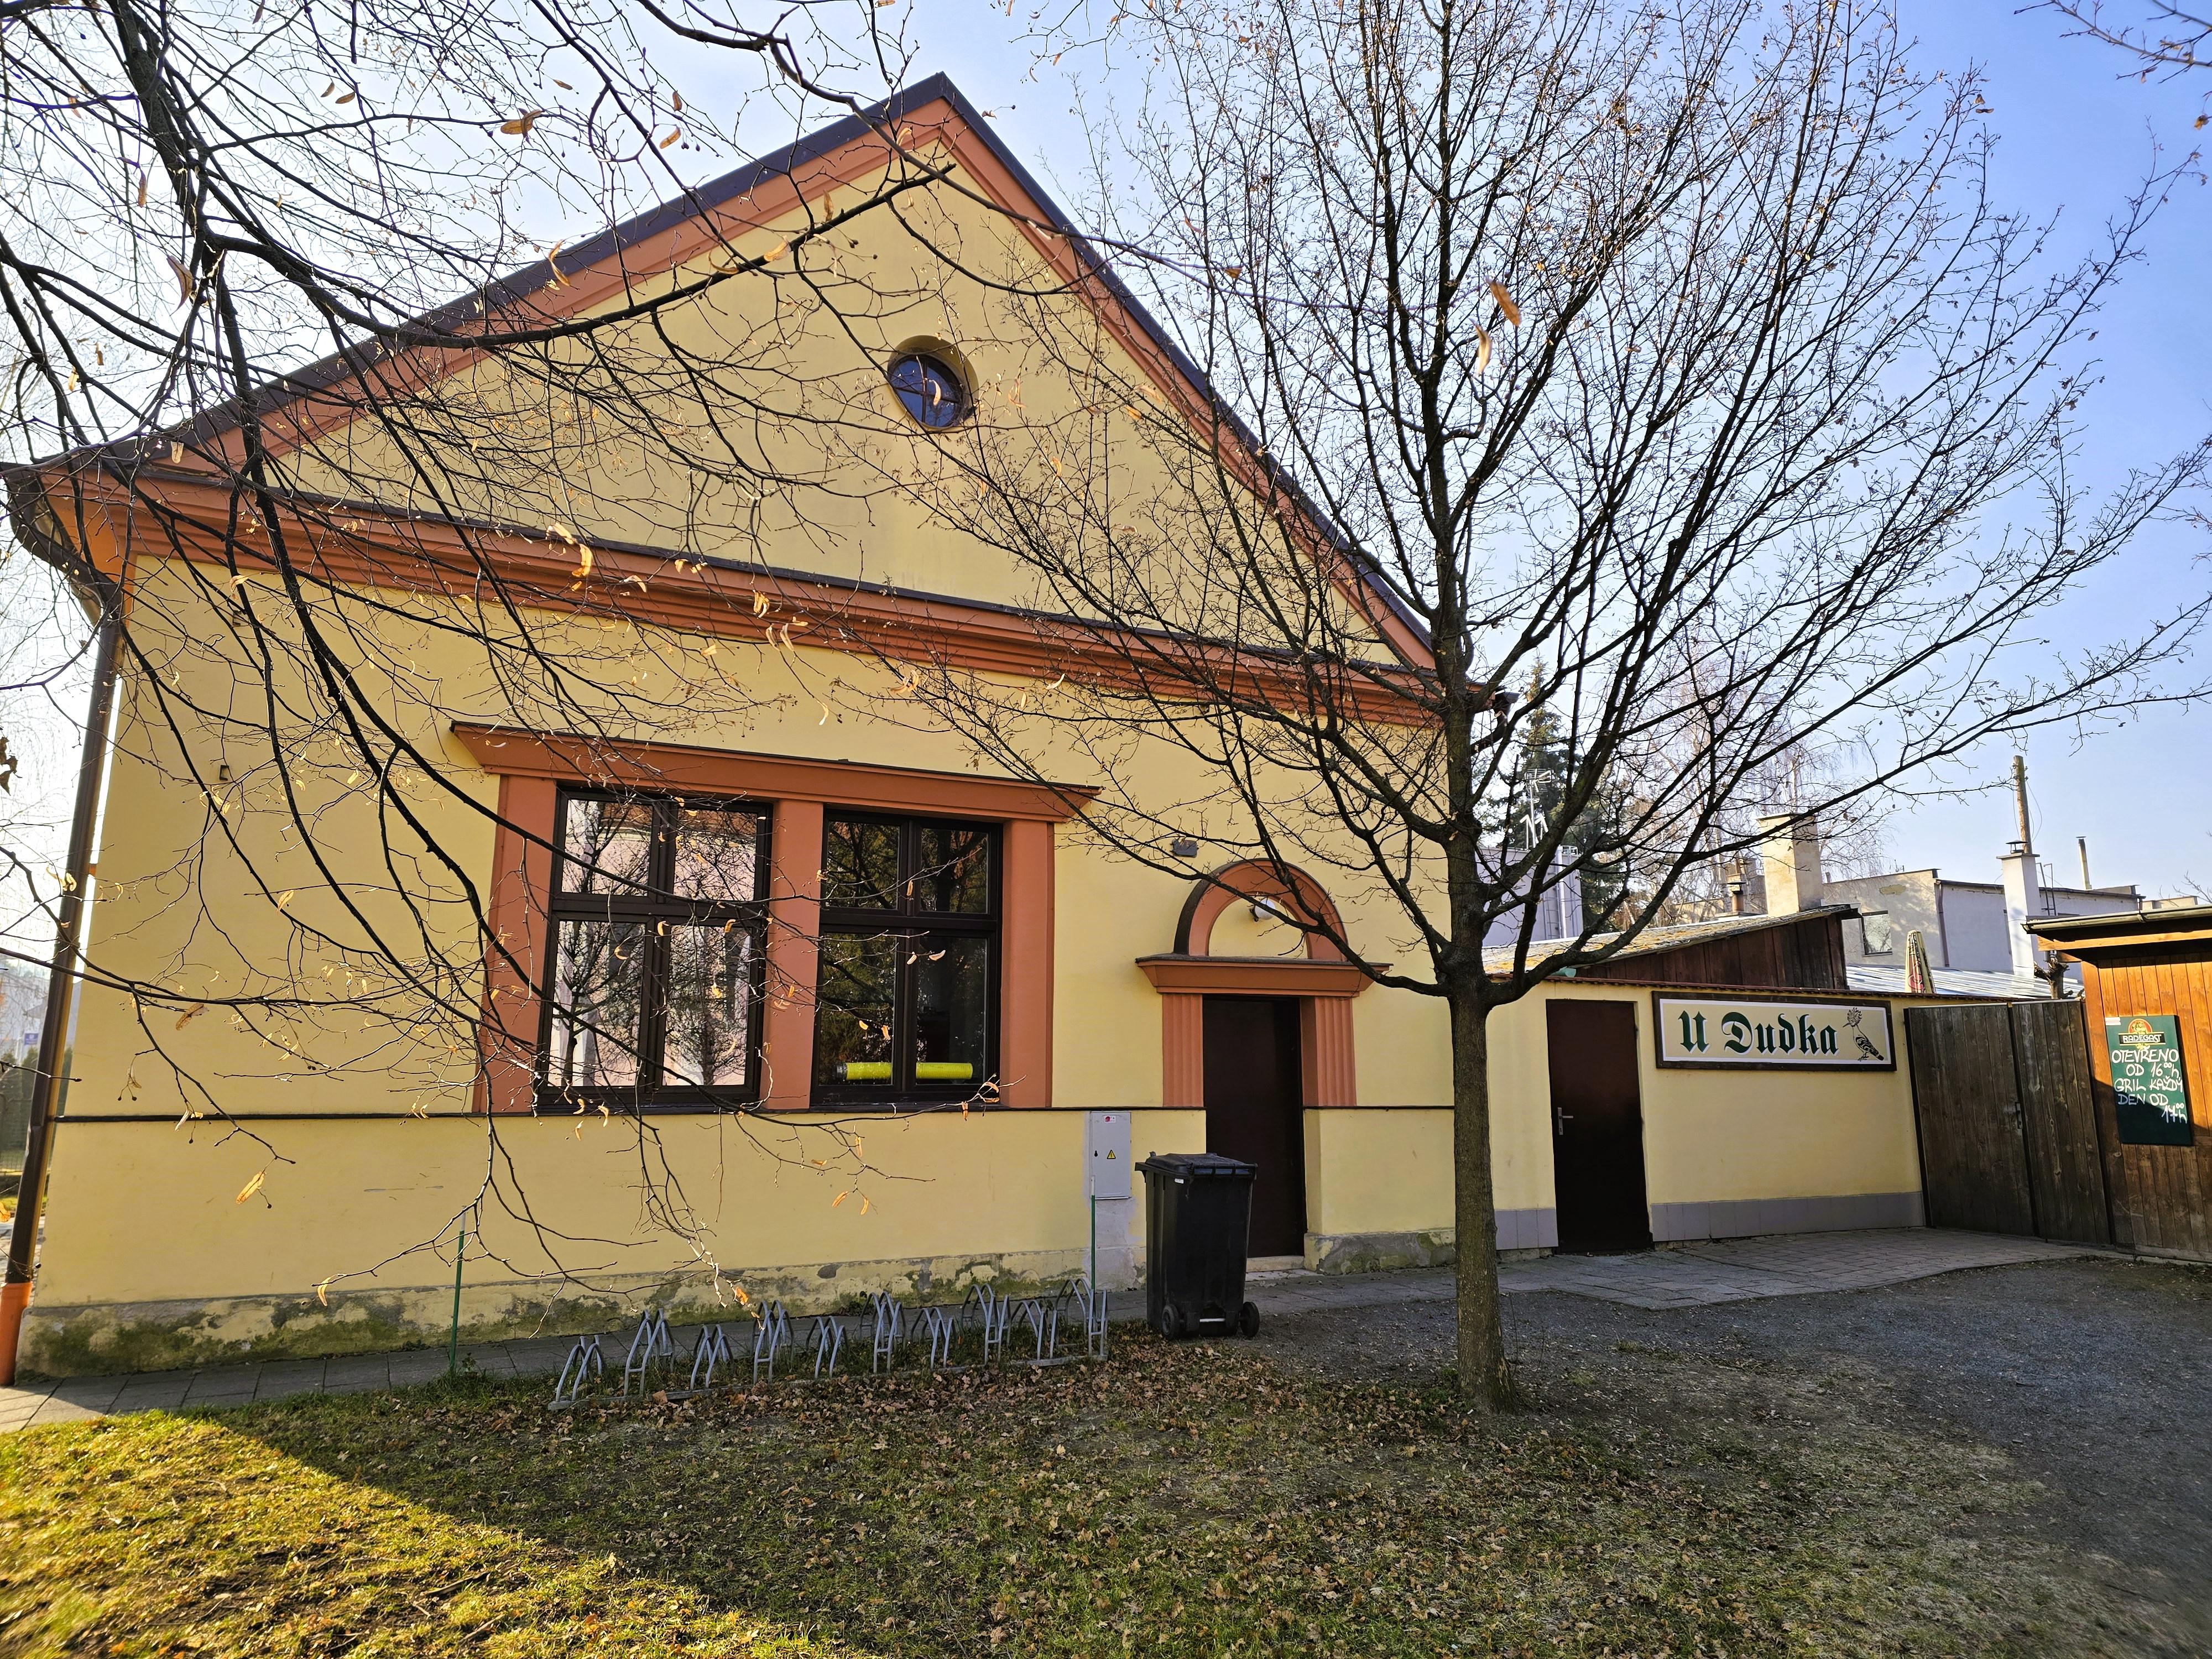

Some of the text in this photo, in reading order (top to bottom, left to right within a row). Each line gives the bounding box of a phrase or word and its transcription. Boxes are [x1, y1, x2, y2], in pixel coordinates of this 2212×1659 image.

[1721, 1011, 1839, 1056] Dudka
[2122, 1034, 2162, 1044] RADEGAST
[2111, 1045, 2179, 1063] OTEVŘENO
[2126, 1063, 2145, 1077] OD
[2114, 1075, 2183, 1093] GRIL KAŽDÝ
[2117, 1093, 2169, 1107] DEN OD
